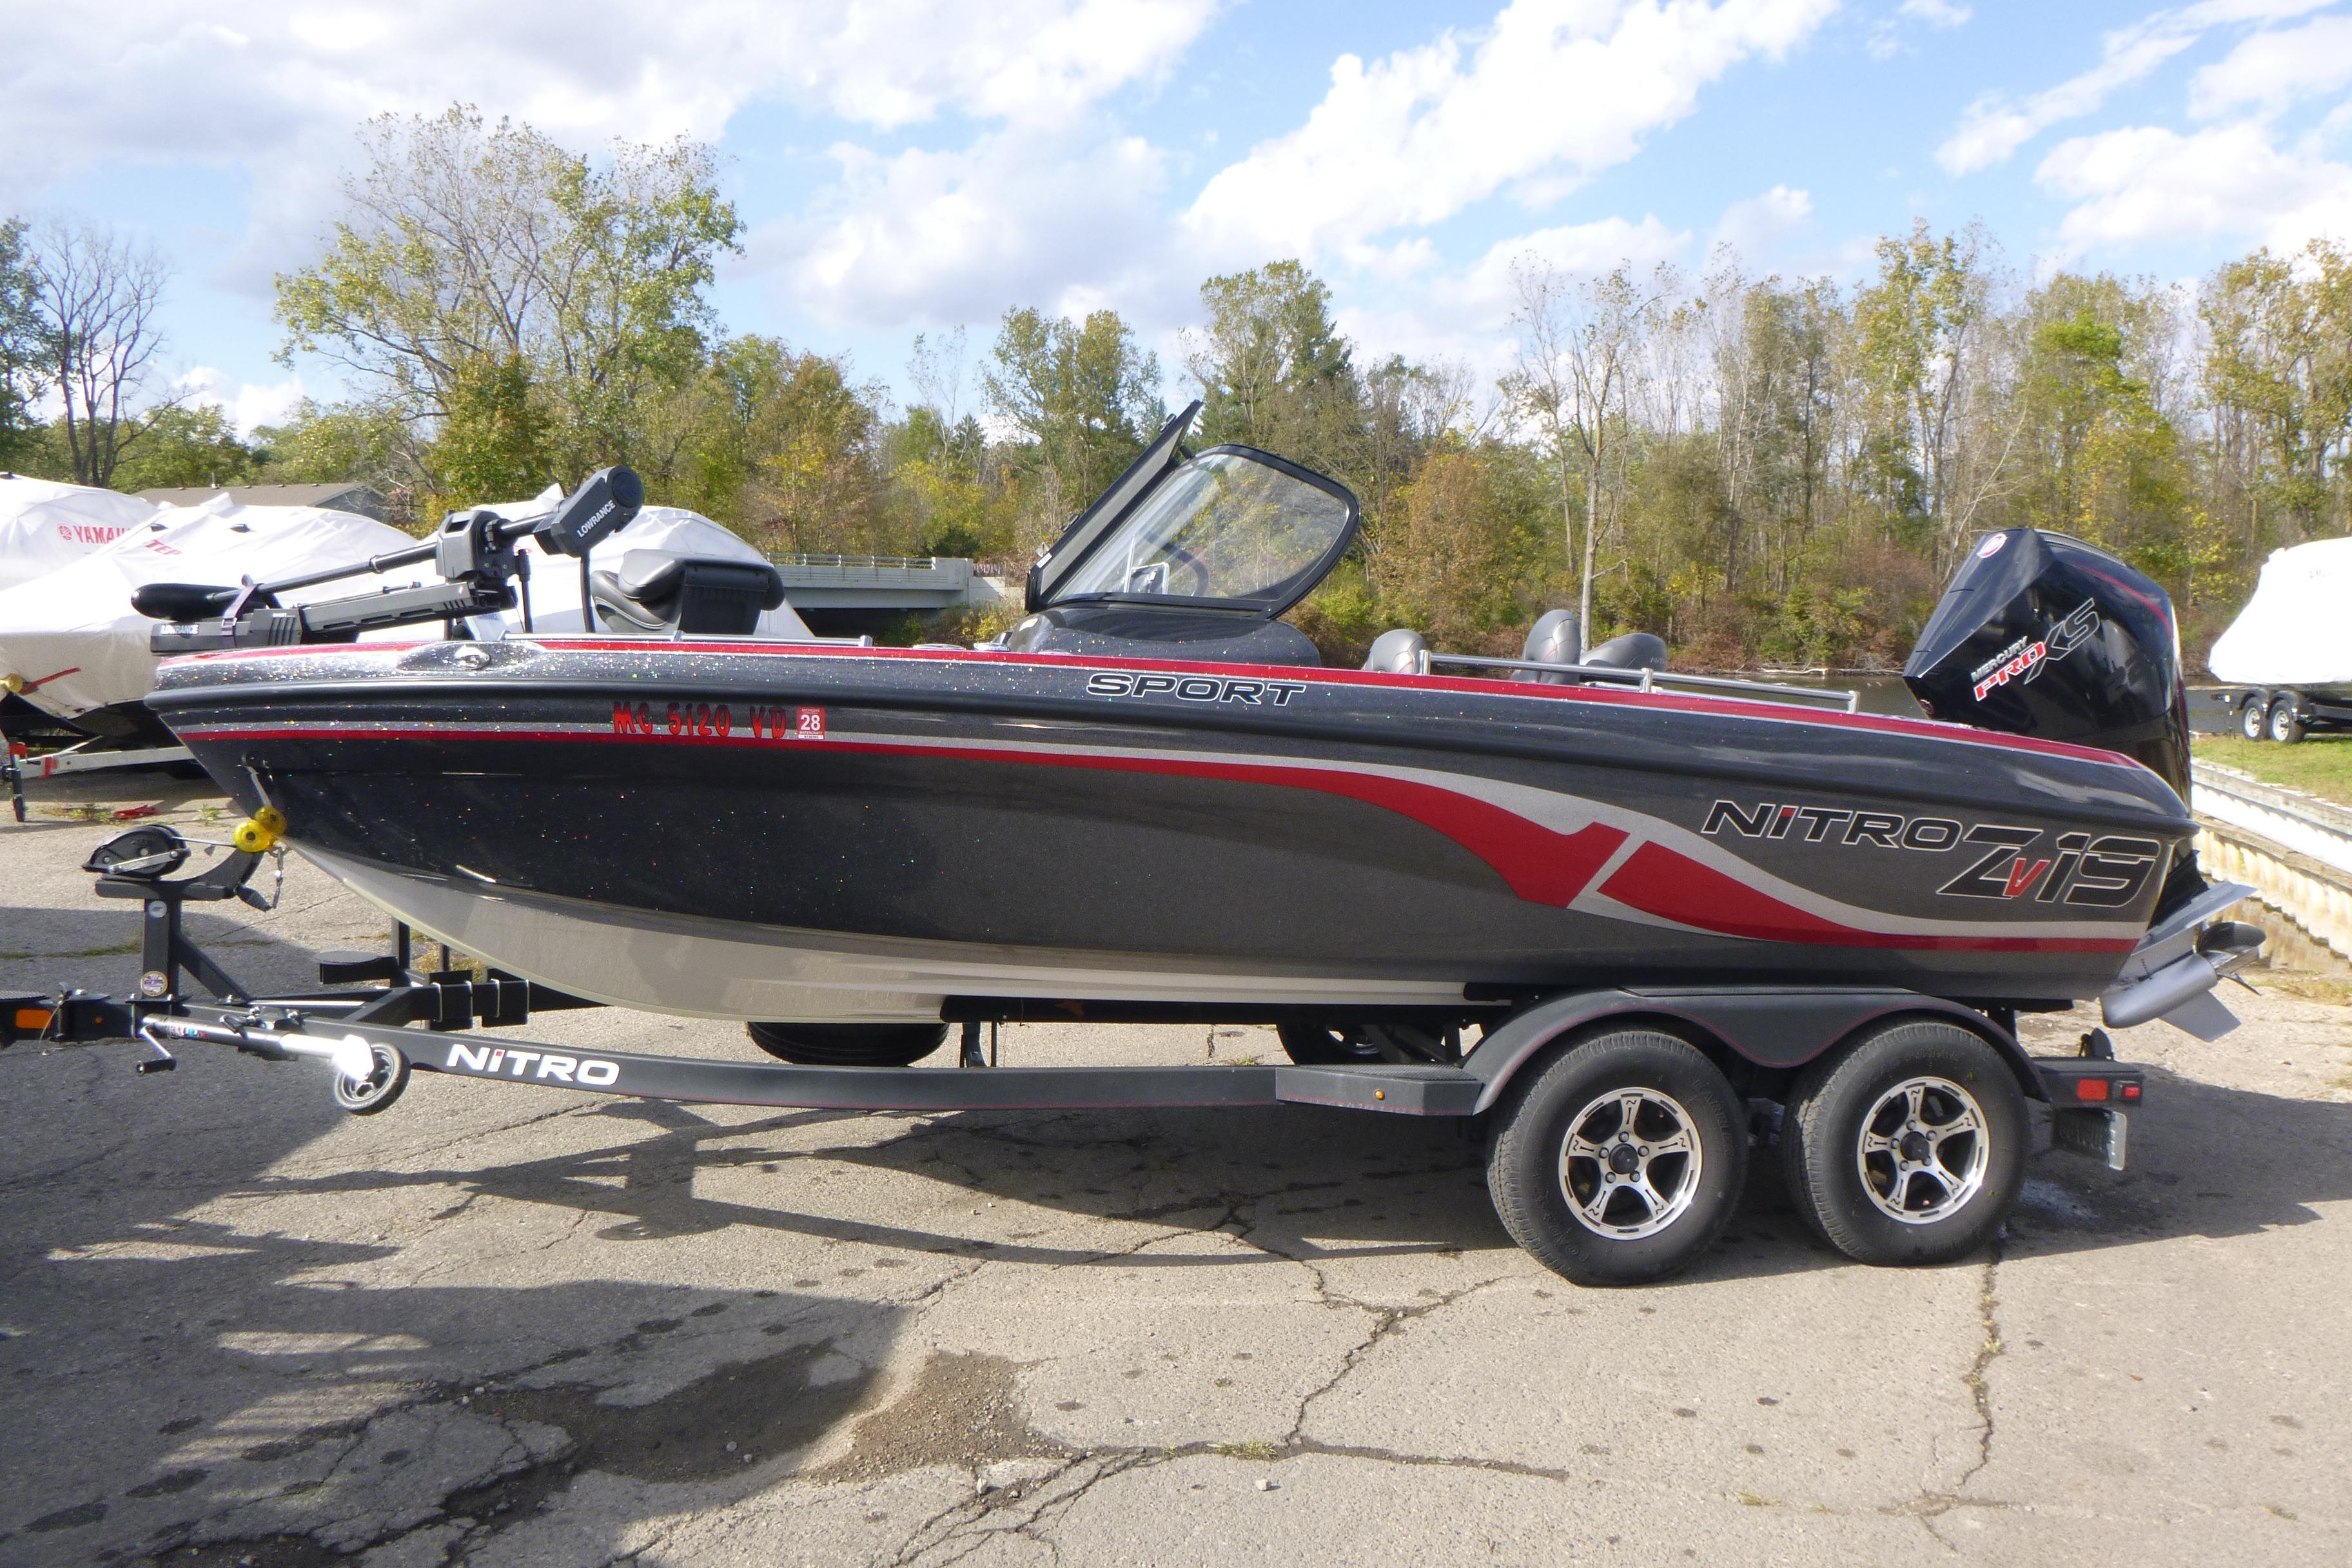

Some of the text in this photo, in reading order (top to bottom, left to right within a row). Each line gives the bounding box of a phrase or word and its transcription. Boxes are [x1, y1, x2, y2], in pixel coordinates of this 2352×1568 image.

[73, 525, 131, 544] YAMA
[576, 500, 616, 538] LOWRANCE
[1970, 635, 2028, 683] MERCURY
[1974, 641, 2046, 702] PRO
[1086, 672, 1307, 707] SPORT
[613, 701, 787, 740] MC 5120 VD
[800, 714, 821, 731] 28
[446, 1043, 620, 1086] NITRO
